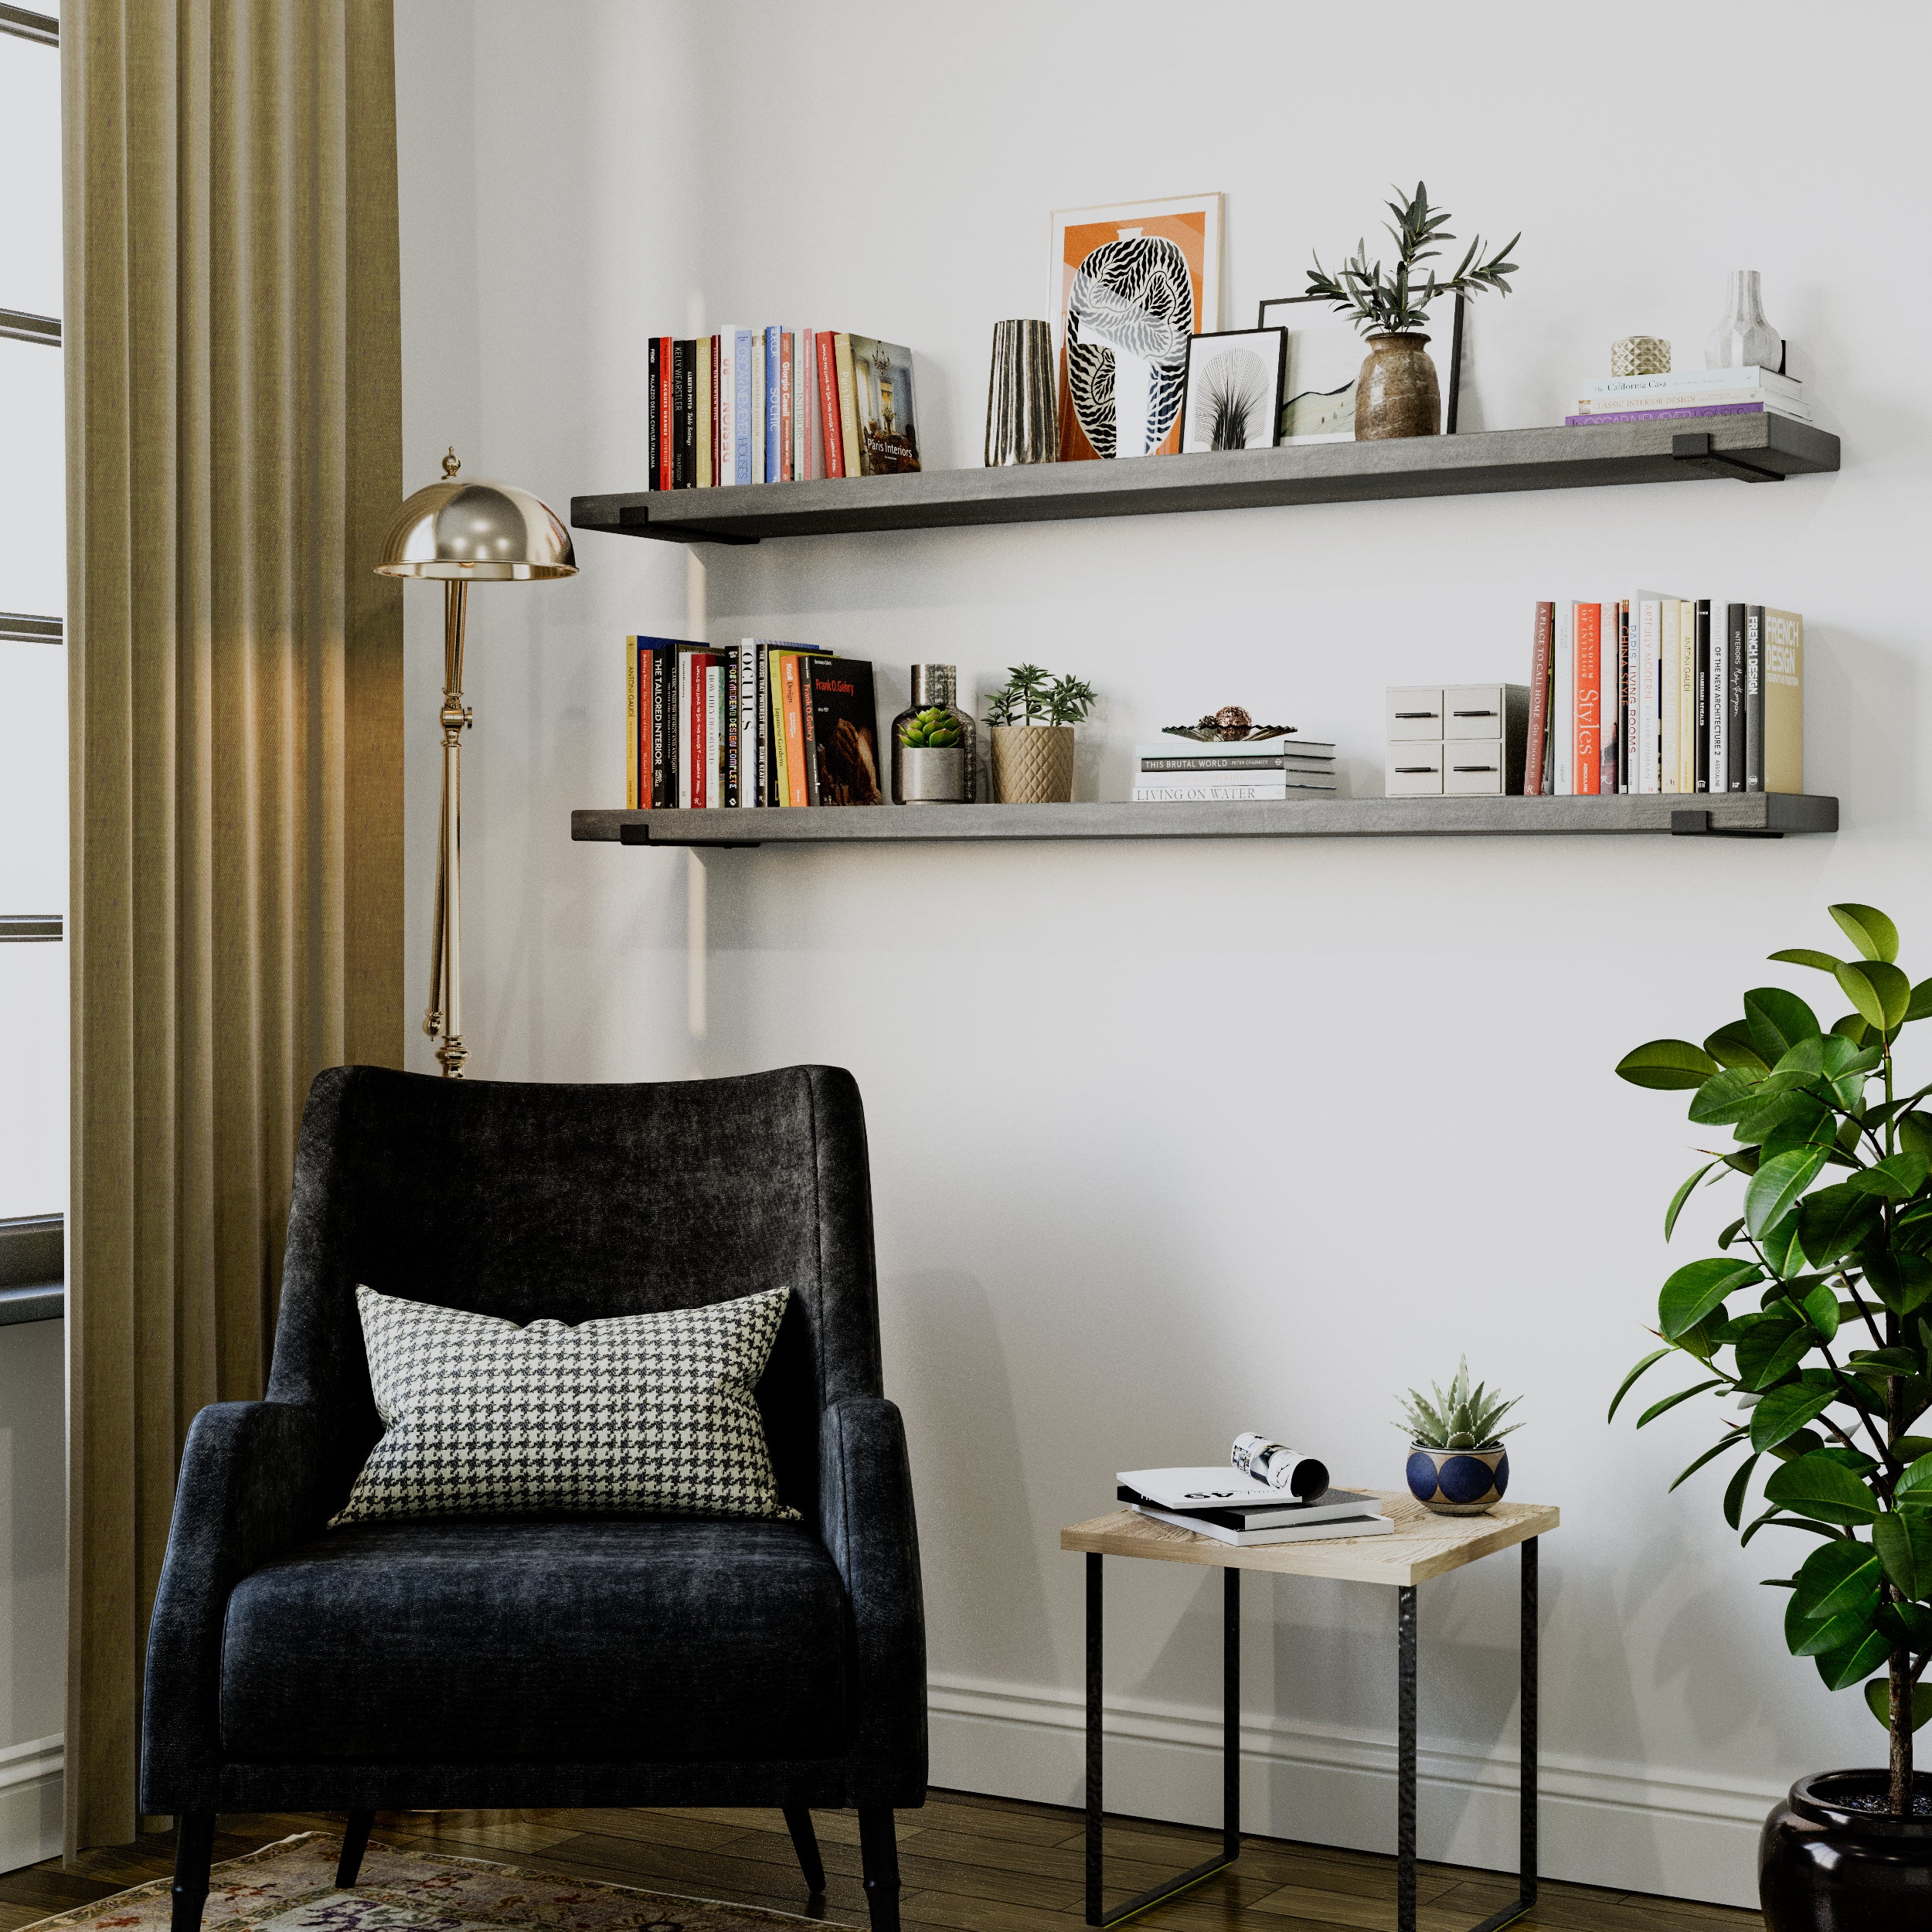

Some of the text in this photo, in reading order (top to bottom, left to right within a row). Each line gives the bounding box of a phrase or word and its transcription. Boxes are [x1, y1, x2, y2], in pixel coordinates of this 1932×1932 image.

[738, 346, 748, 383] OSCAR
[781, 362, 790, 391] Giorgio
[1607, 383, 1646, 391] California
[1648, 379, 1667, 388] Casa
[1666, 396, 1696, 404] DESIGN
[738, 386, 748, 436] NIEMEYER
[770, 387, 779, 432] SO CHIC
[840, 372, 852, 432] Paris Interiors
[738, 438, 748, 479] HOUSES
[867, 438, 884, 452] Paris
[885, 442, 913, 457] Interiors
[1538, 617, 1546, 645] PLACE
[1581, 609, 1587, 624] OF
[1766, 615, 1799, 648] FRENCH
[1537, 649, 1544, 661] TO
[1715, 647, 1721, 656] OF
[1748, 616, 1758, 696] FRENCH DESIGN
[1766, 644, 1795, 675] DESIGN
[742, 652, 753, 730] OCULUS
[815, 679, 854, 696] Frank O. Gehry
[1644, 652, 1652, 699] MODERN
[729, 719, 737, 747] DESIGN
[1573, 689, 1600, 755] Styles
[729, 749, 737, 789] COMPLETE
[1137, 787, 1256, 801] LIVING ON WATER
